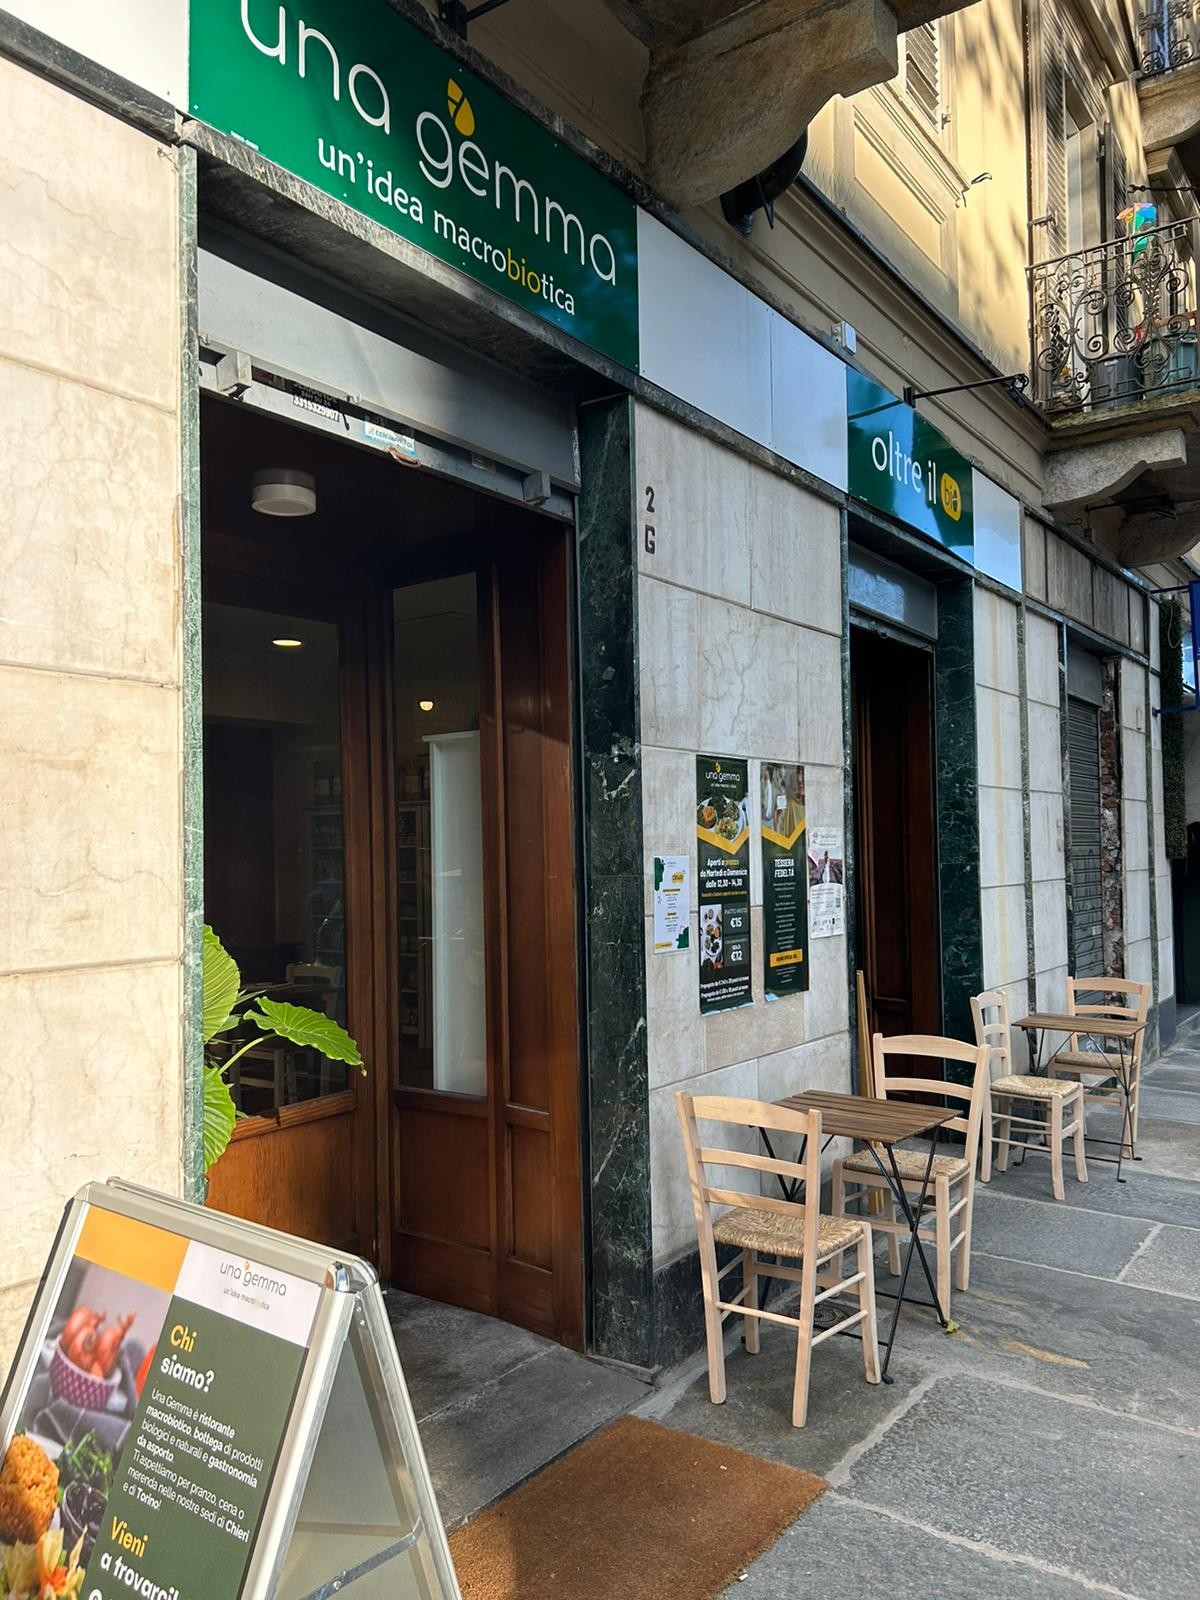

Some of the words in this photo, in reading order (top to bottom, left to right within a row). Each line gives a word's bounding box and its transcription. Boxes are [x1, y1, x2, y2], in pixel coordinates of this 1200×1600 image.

[241, 0, 390, 135] una
[416, 111, 617, 286] gemma
[318, 138, 423, 224] un'idea
[434, 209, 576, 316] macrobiotica
[872, 431, 922, 493] oltre
[928, 460, 937, 504] il
[646, 486, 655, 513] 2
[645, 524, 655, 554] G
[705, 771, 718, 780] una
[719, 772, 740, 782] gemma
[220, 1262, 242, 1279] una
[243, 1271, 287, 1296] gemma
[171, 1324, 198, 1352] Chi
[160, 1354, 215, 1392] siamo?
[152, 1388, 166, 1405] Una
[165, 1397, 193, 1418] Gemma
[198, 1410, 236, 1439] ristorante
[137, 1434, 147, 1448] da
[142, 1419, 170, 1442] biologici
[169, 1434, 176, 1444] e
[175, 1437, 203, 1461] naturali
[202, 1452, 209, 1462] e
[208, 1455, 258, 1489] gastronomia
[193, 1427, 224, 1452] bottega
[223, 1442, 232, 1456] di
[231, 1449, 264, 1472] prodotti
[123, 1482, 129, 1492] e
[128, 1483, 137, 1496] di
[136, 1487, 163, 1511] Torino!
[127, 1466, 158, 1490] merenda
[157, 1481, 177, 1501] nelle
[176, 1492, 201, 1514] nostre
[200, 1507, 217, 1523] sedi
[216, 1515, 226, 1528] di
[225, 1521, 250, 1543] Chieri
[133, 1449, 141, 1461] Ti
[140, 1454, 178, 1482] aspettiamo
[176, 1474, 191, 1491] per
[218, 1499, 238, 1515] cena
[237, 1509, 245, 1520] o
[111, 1516, 149, 1558] Vieni
[100, 1552, 112, 1571] a
